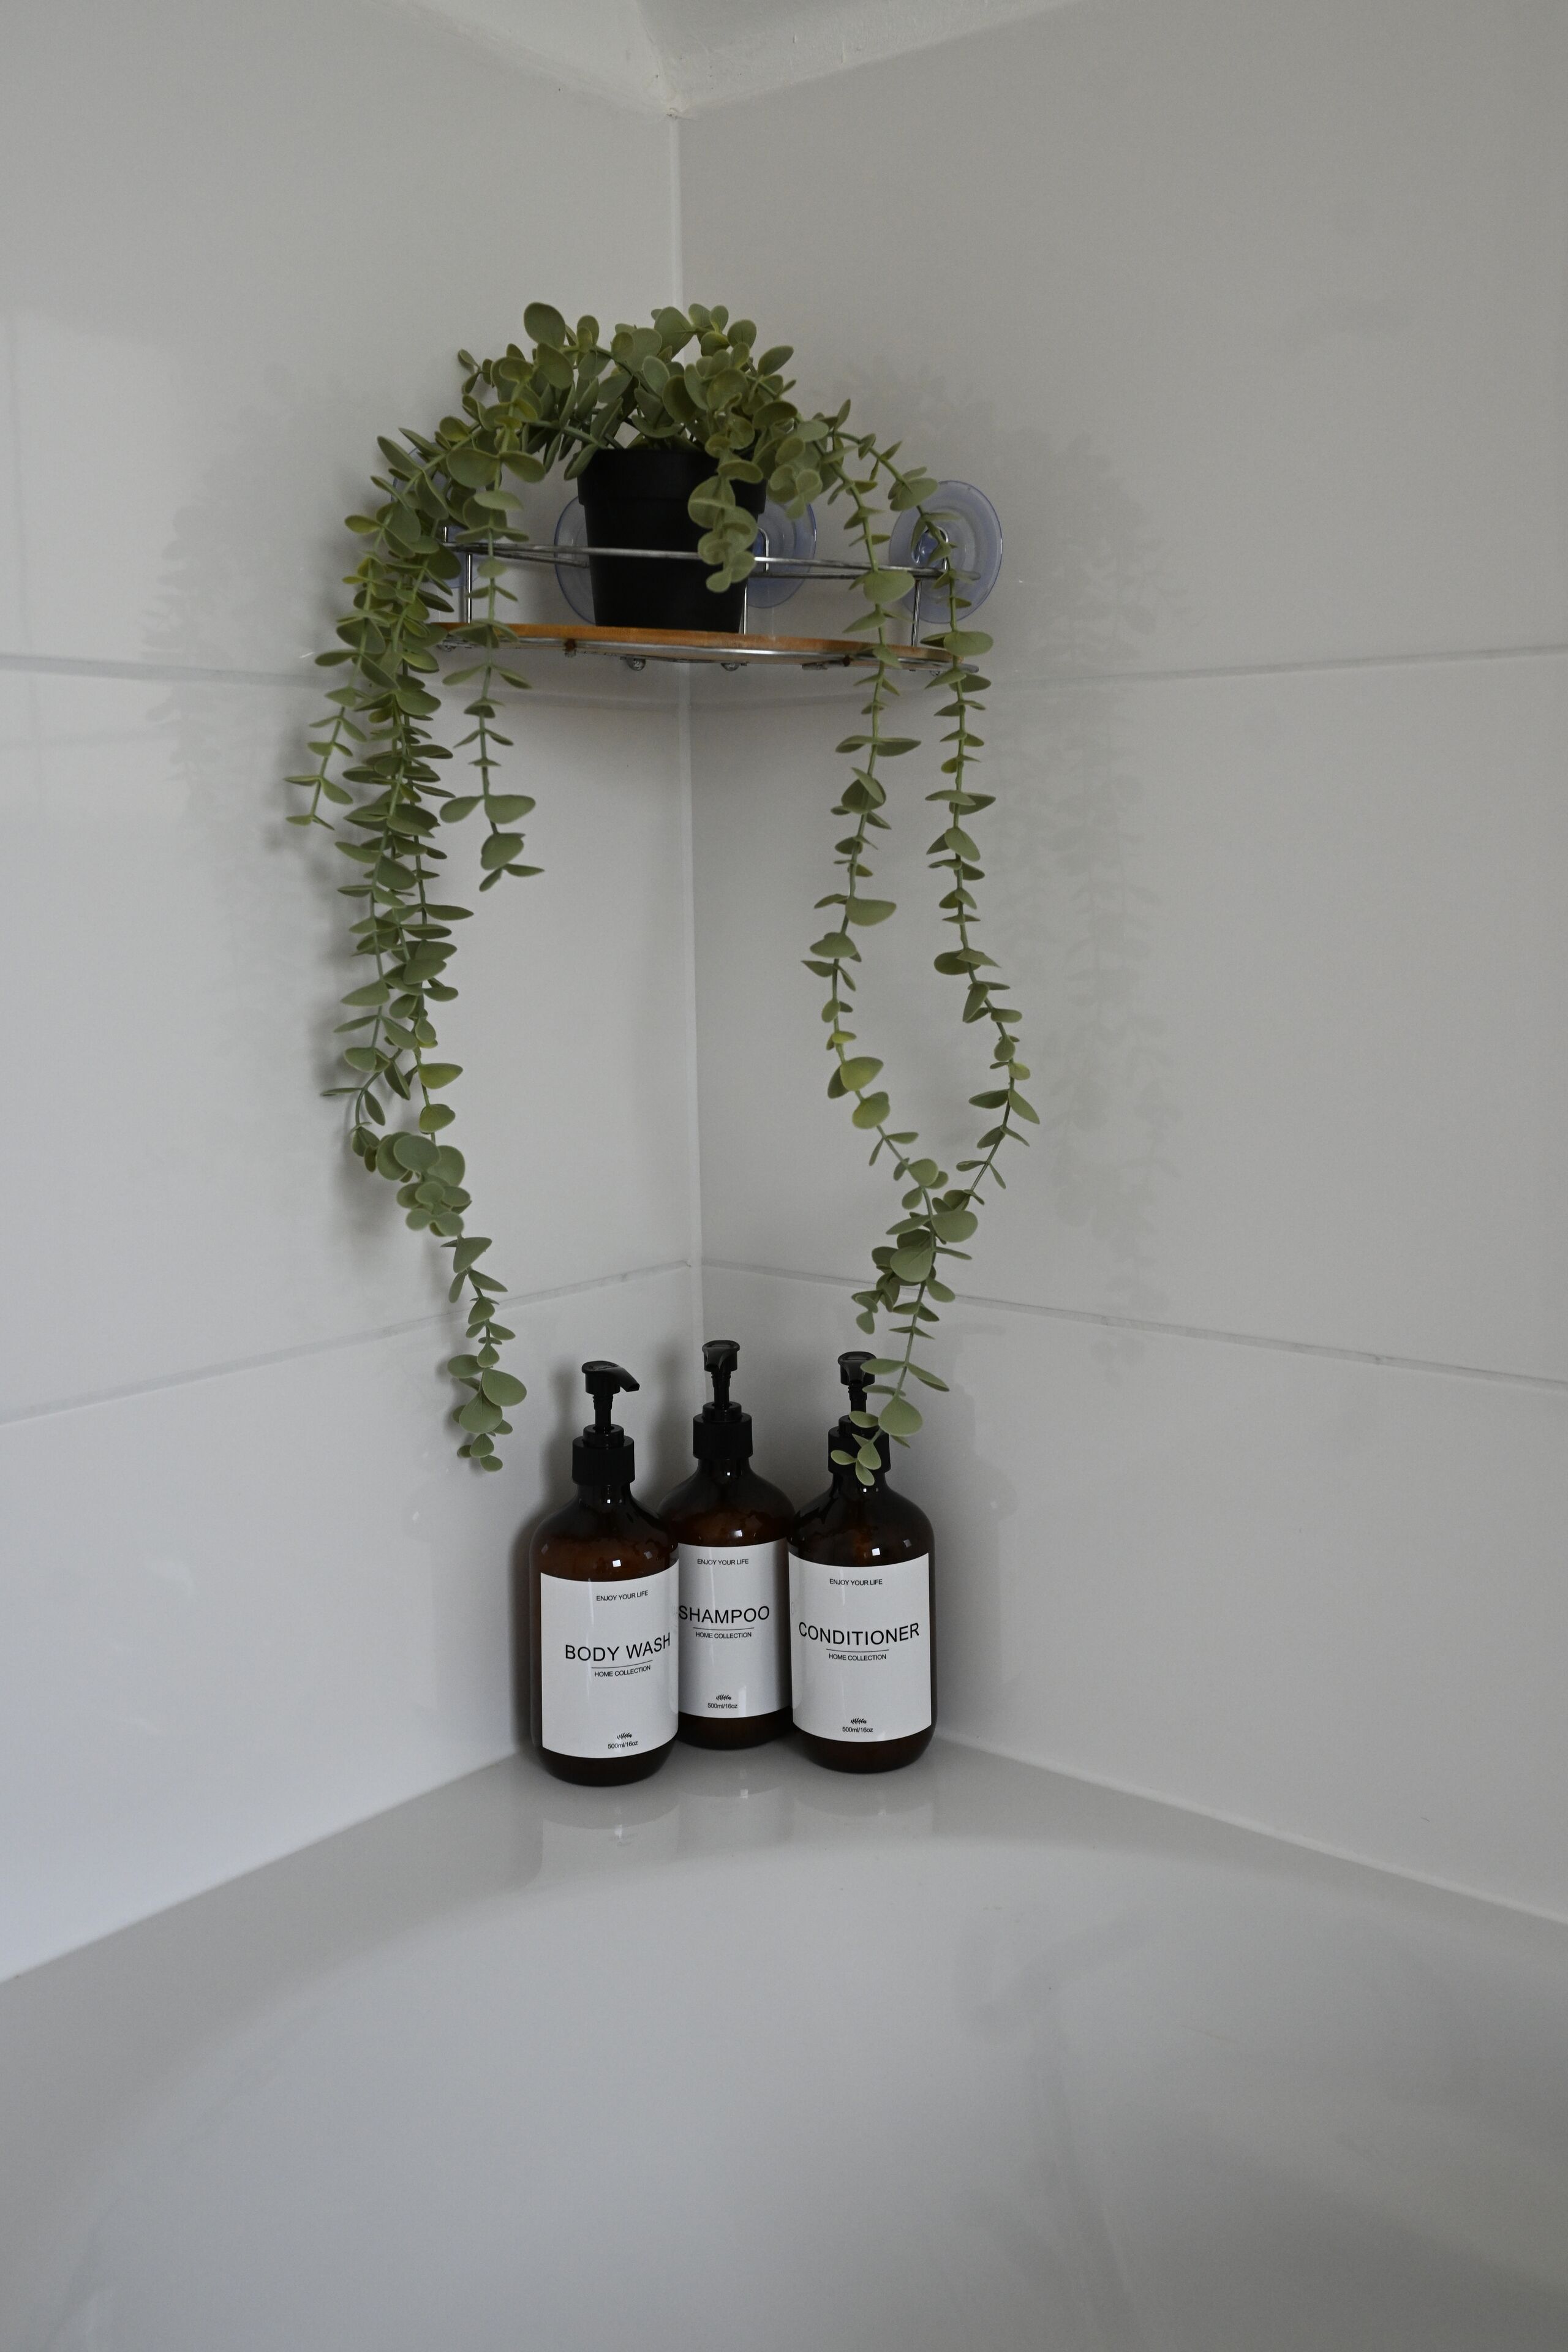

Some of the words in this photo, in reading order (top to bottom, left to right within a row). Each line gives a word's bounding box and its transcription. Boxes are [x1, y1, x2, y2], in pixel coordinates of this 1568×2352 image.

[618, 1592, 636, 1600] YOUR
[636, 1589, 649, 1598] LIFE
[679, 1605, 770, 1624] SHAMPOO
[799, 1621, 920, 1646] CONDITIONER
[565, 1644, 620, 1662] BODY
[625, 1632, 671, 1659] WASH
[828, 1653, 847, 1661] HOME
[848, 1653, 887, 1662] COLLECTION
[614, 1664, 651, 1677] COLLECTION
